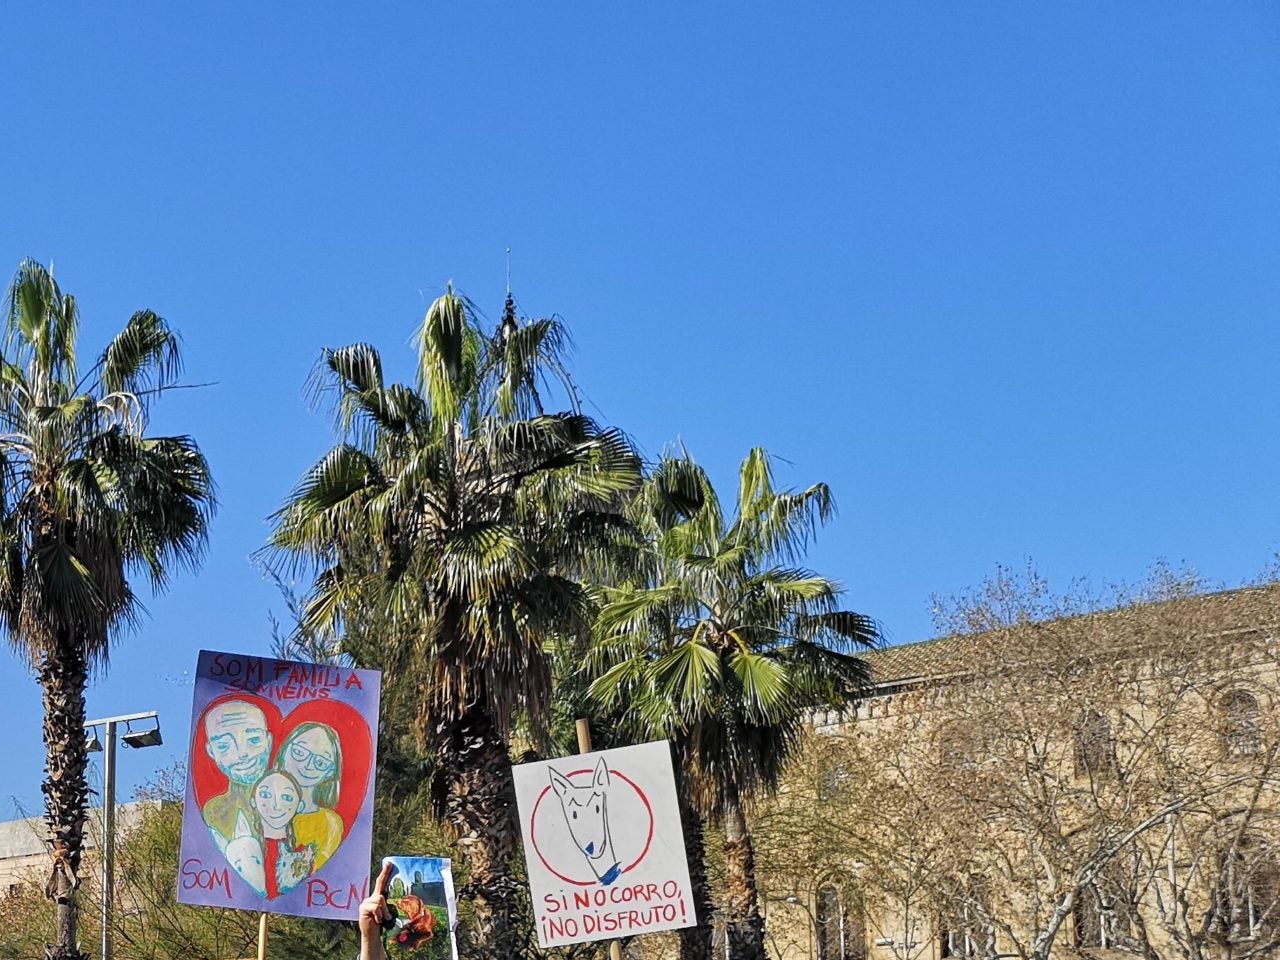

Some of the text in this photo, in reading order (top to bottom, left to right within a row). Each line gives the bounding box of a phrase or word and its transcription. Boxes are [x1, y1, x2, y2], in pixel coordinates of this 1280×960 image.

[210, 654, 263, 681] SOM
[306, 877, 368, 910] BCN
[574, 889, 606, 910] NO
[610, 880, 682, 903] CORRO,
